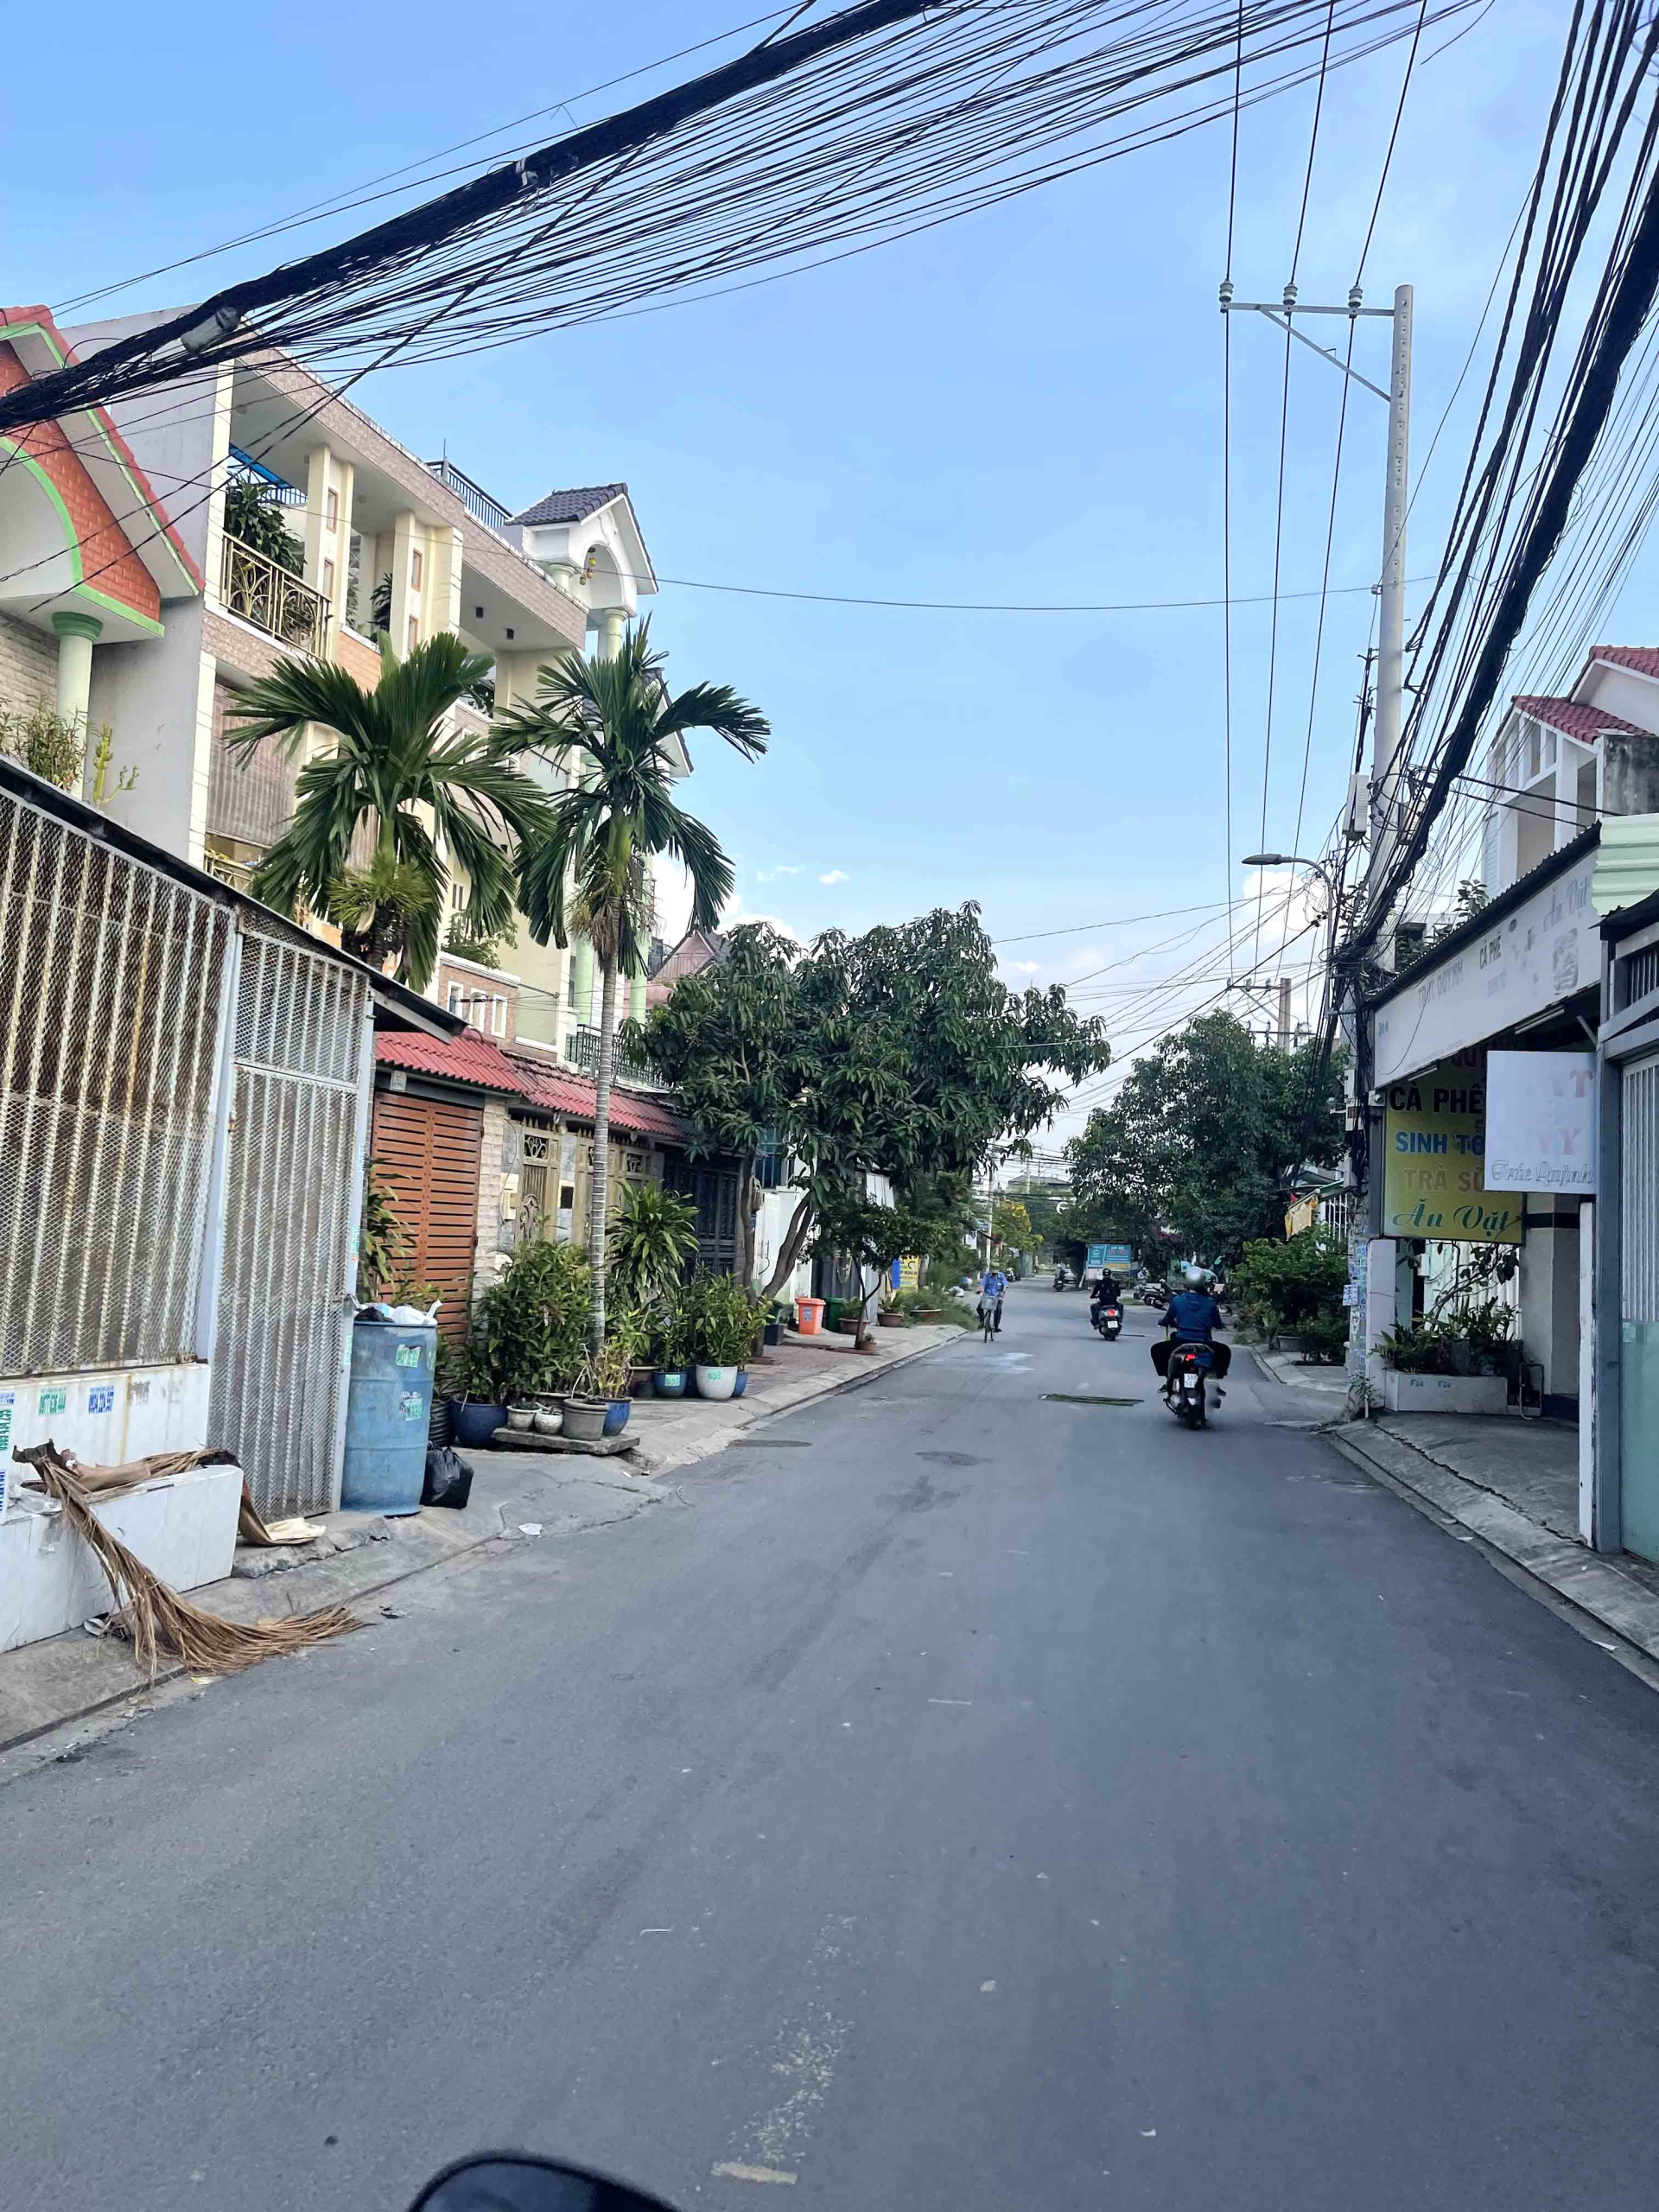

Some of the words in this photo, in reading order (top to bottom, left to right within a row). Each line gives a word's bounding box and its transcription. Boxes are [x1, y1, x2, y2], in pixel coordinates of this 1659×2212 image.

[1389, 1082, 1422, 1112] CÀ
[1433, 1083, 1484, 1114] PHÊ
[1395, 1131, 1447, 1154] SINH
[1392, 1198, 1444, 1228] Ăn
[1453, 1205, 1518, 1236] Vặt
